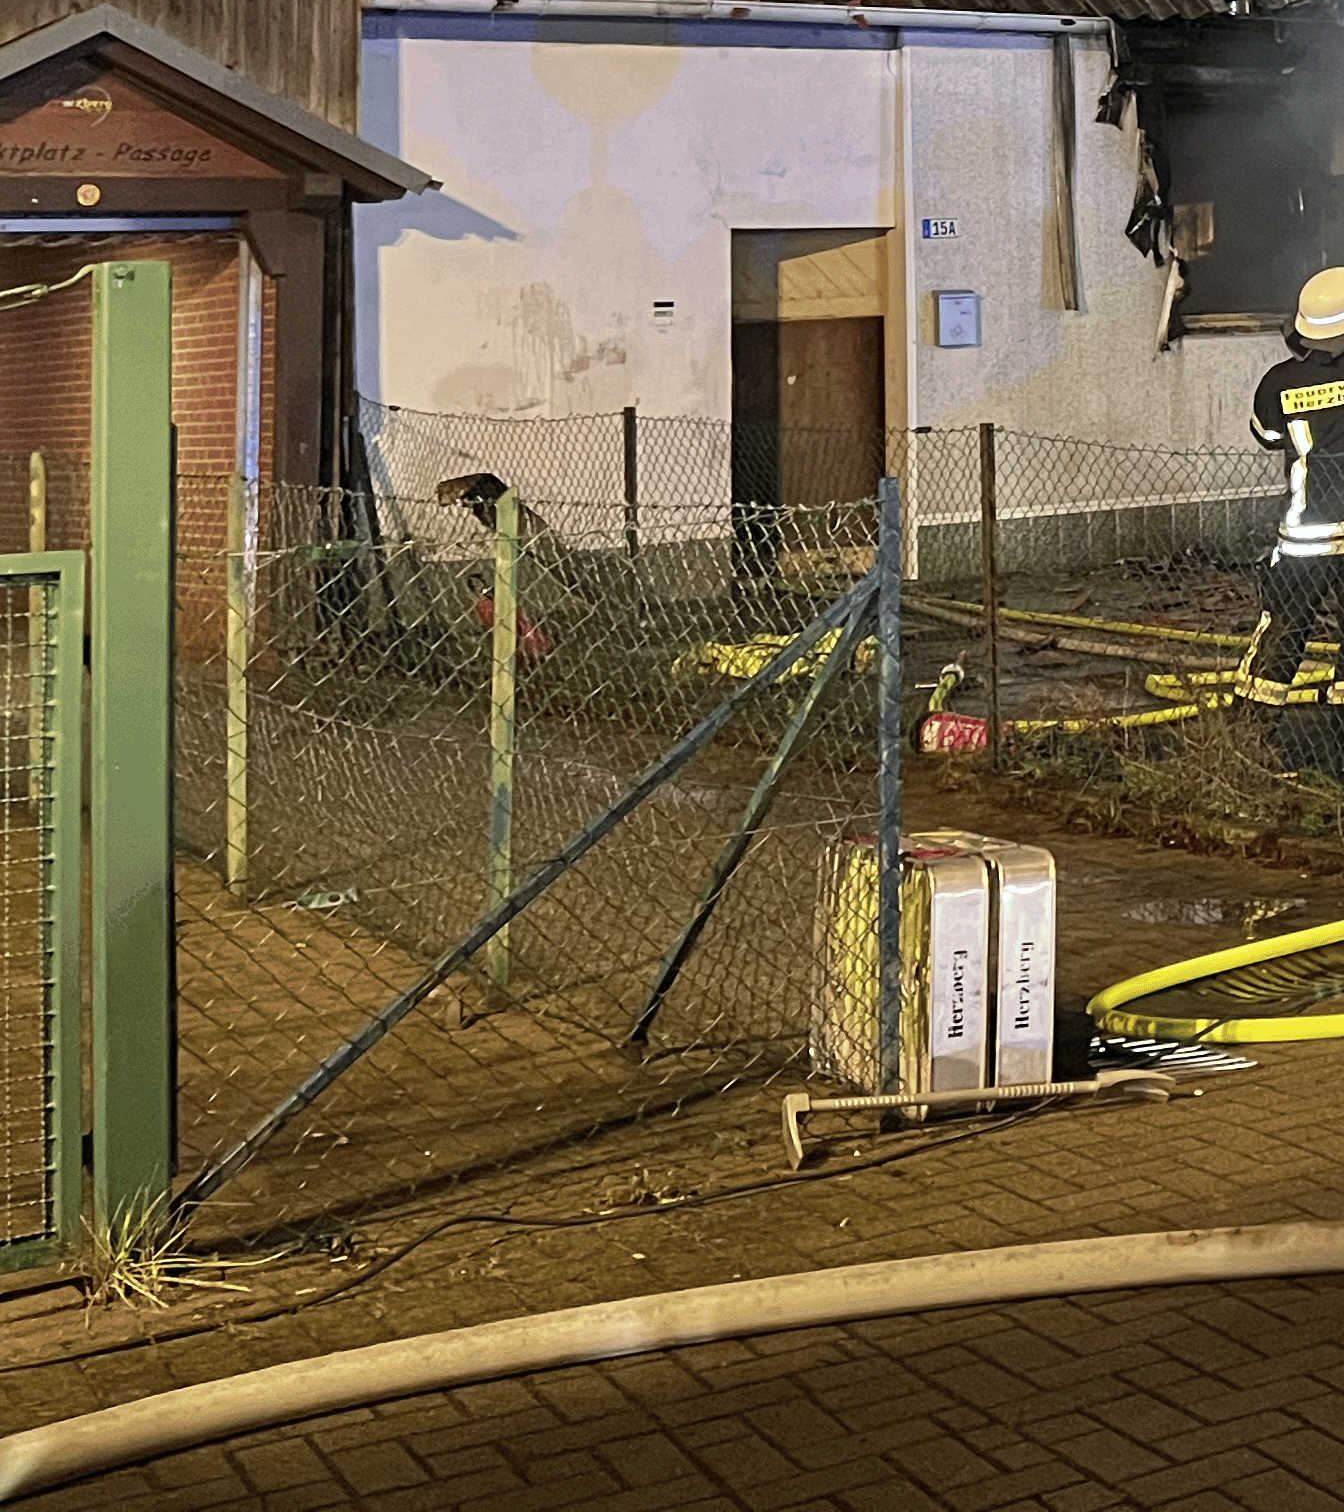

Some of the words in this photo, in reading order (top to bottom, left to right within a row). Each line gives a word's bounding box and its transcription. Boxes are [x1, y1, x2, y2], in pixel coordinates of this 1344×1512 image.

[113, 141, 212, 168] Passage
[932, 221, 957, 237] 15A
[948, 949, 969, 1039] Herzberg
[1014, 941, 1035, 1030] Herzberg
